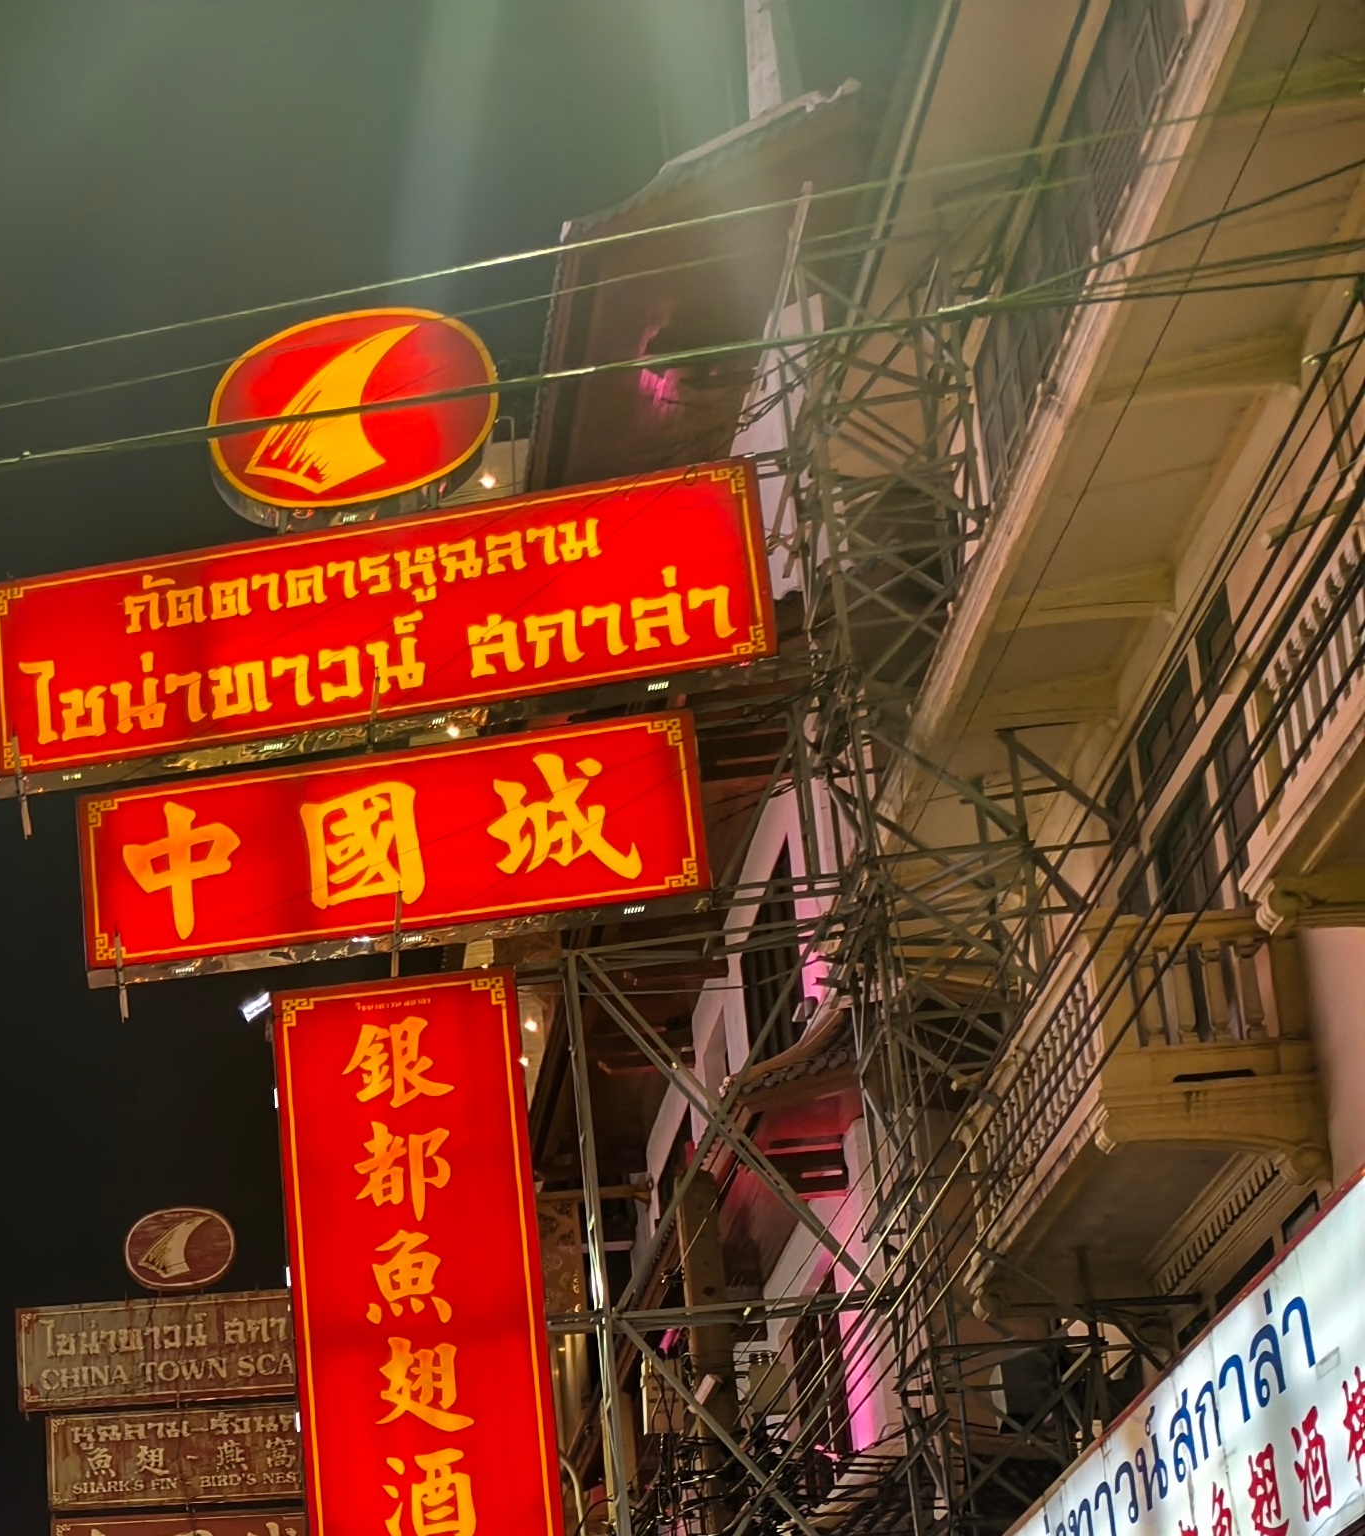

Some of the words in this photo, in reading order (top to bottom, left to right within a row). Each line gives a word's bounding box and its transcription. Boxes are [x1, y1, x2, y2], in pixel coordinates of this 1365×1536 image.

[123, 516, 603, 634] ภัตตาคารหูฉลาม
[18, 615, 425, 747] ไชน่าทาวน์
[470, 564, 740, 680] สกาล่า
[122, 752, 643, 942] 中國城
[39, 1365, 131, 1394] CHINA
[138, 1355, 228, 1384] TOWN
[71, 1476, 145, 1495] SHARK'S
[151, 1476, 179, 1491] FIN
[199, 1472, 257, 1490] BIRD'S
